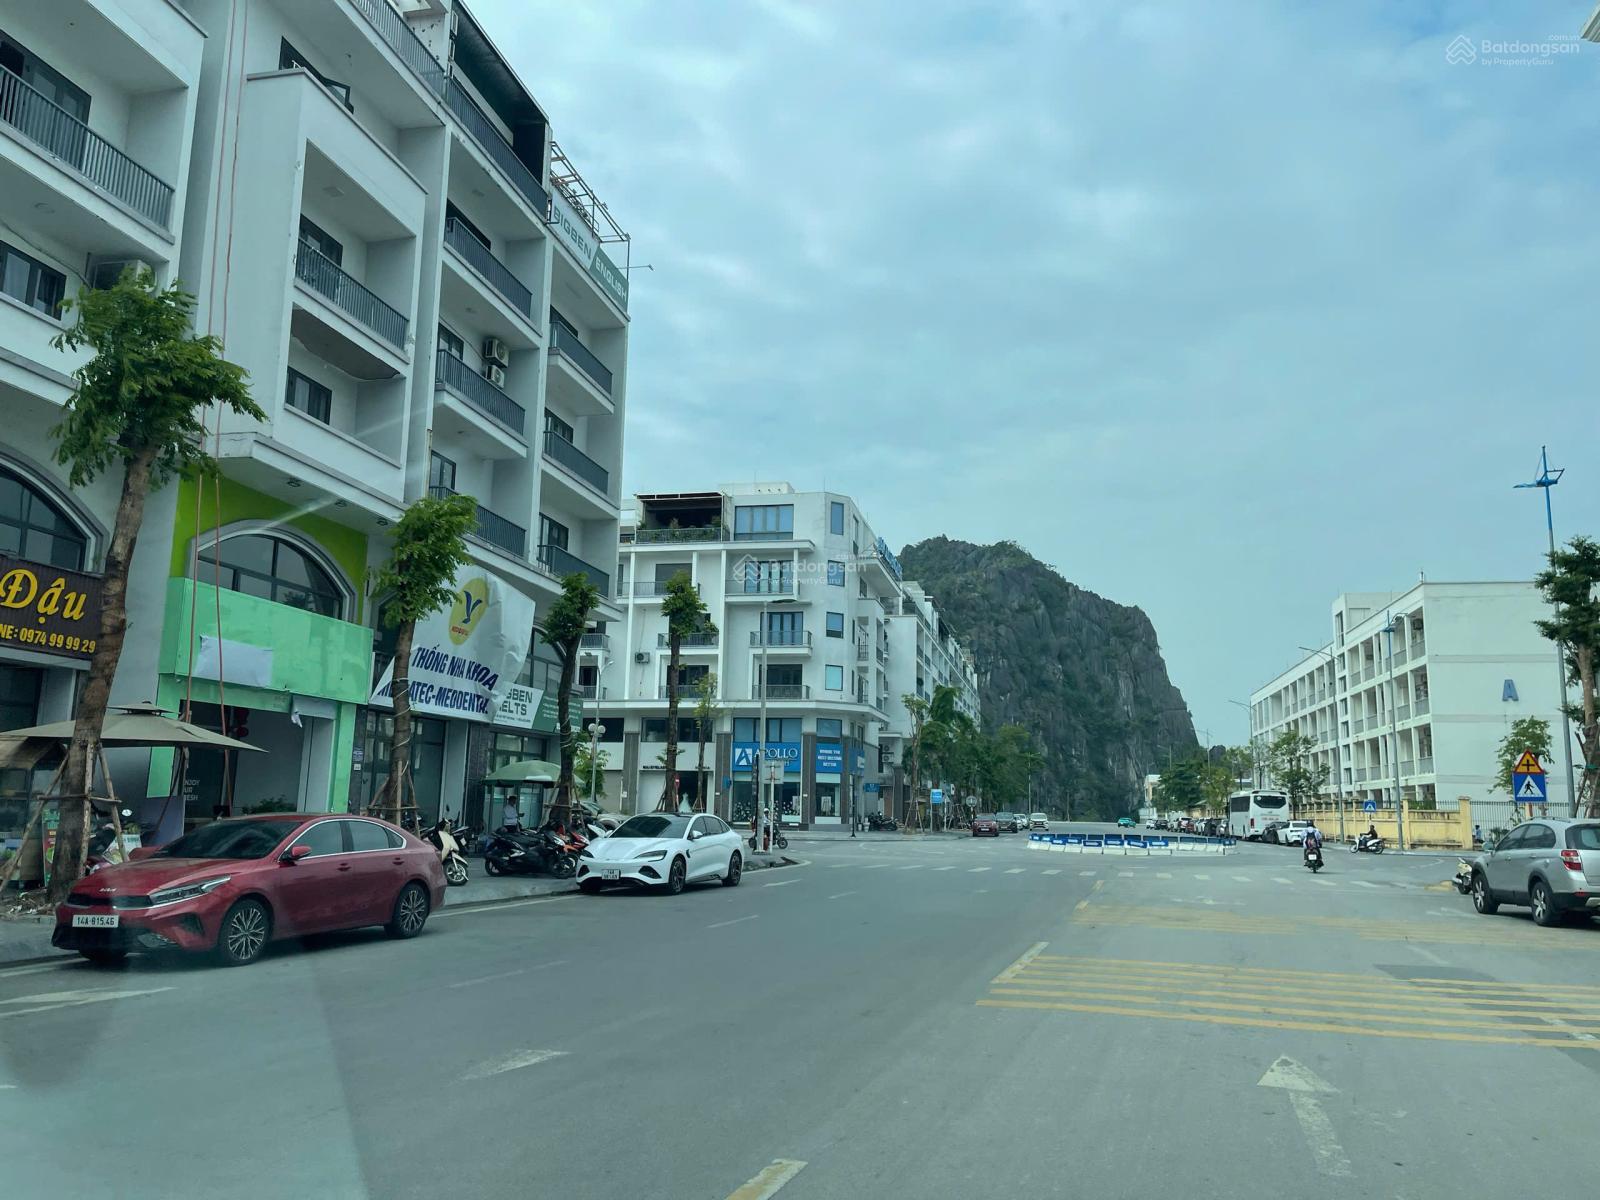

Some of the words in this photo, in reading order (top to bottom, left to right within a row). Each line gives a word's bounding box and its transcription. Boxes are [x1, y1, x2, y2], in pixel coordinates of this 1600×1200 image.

[553, 205, 592, 260] BIGBEN
[595, 256, 627, 303] ENGLISH
[0, 569, 87, 623] Đậu
[20, 627, 47, 645] 0974
[49, 633, 64, 648] 99
[65, 636, 81, 651] 99
[81, 639, 96, 653] 29
[411, 643, 449, 674] THỐNG
[449, 655, 466, 679] NHA
[466, 660, 499, 691] KHOA
[1502, 679, 1519, 701] A
[754, 748, 798, 759] AOLLO
